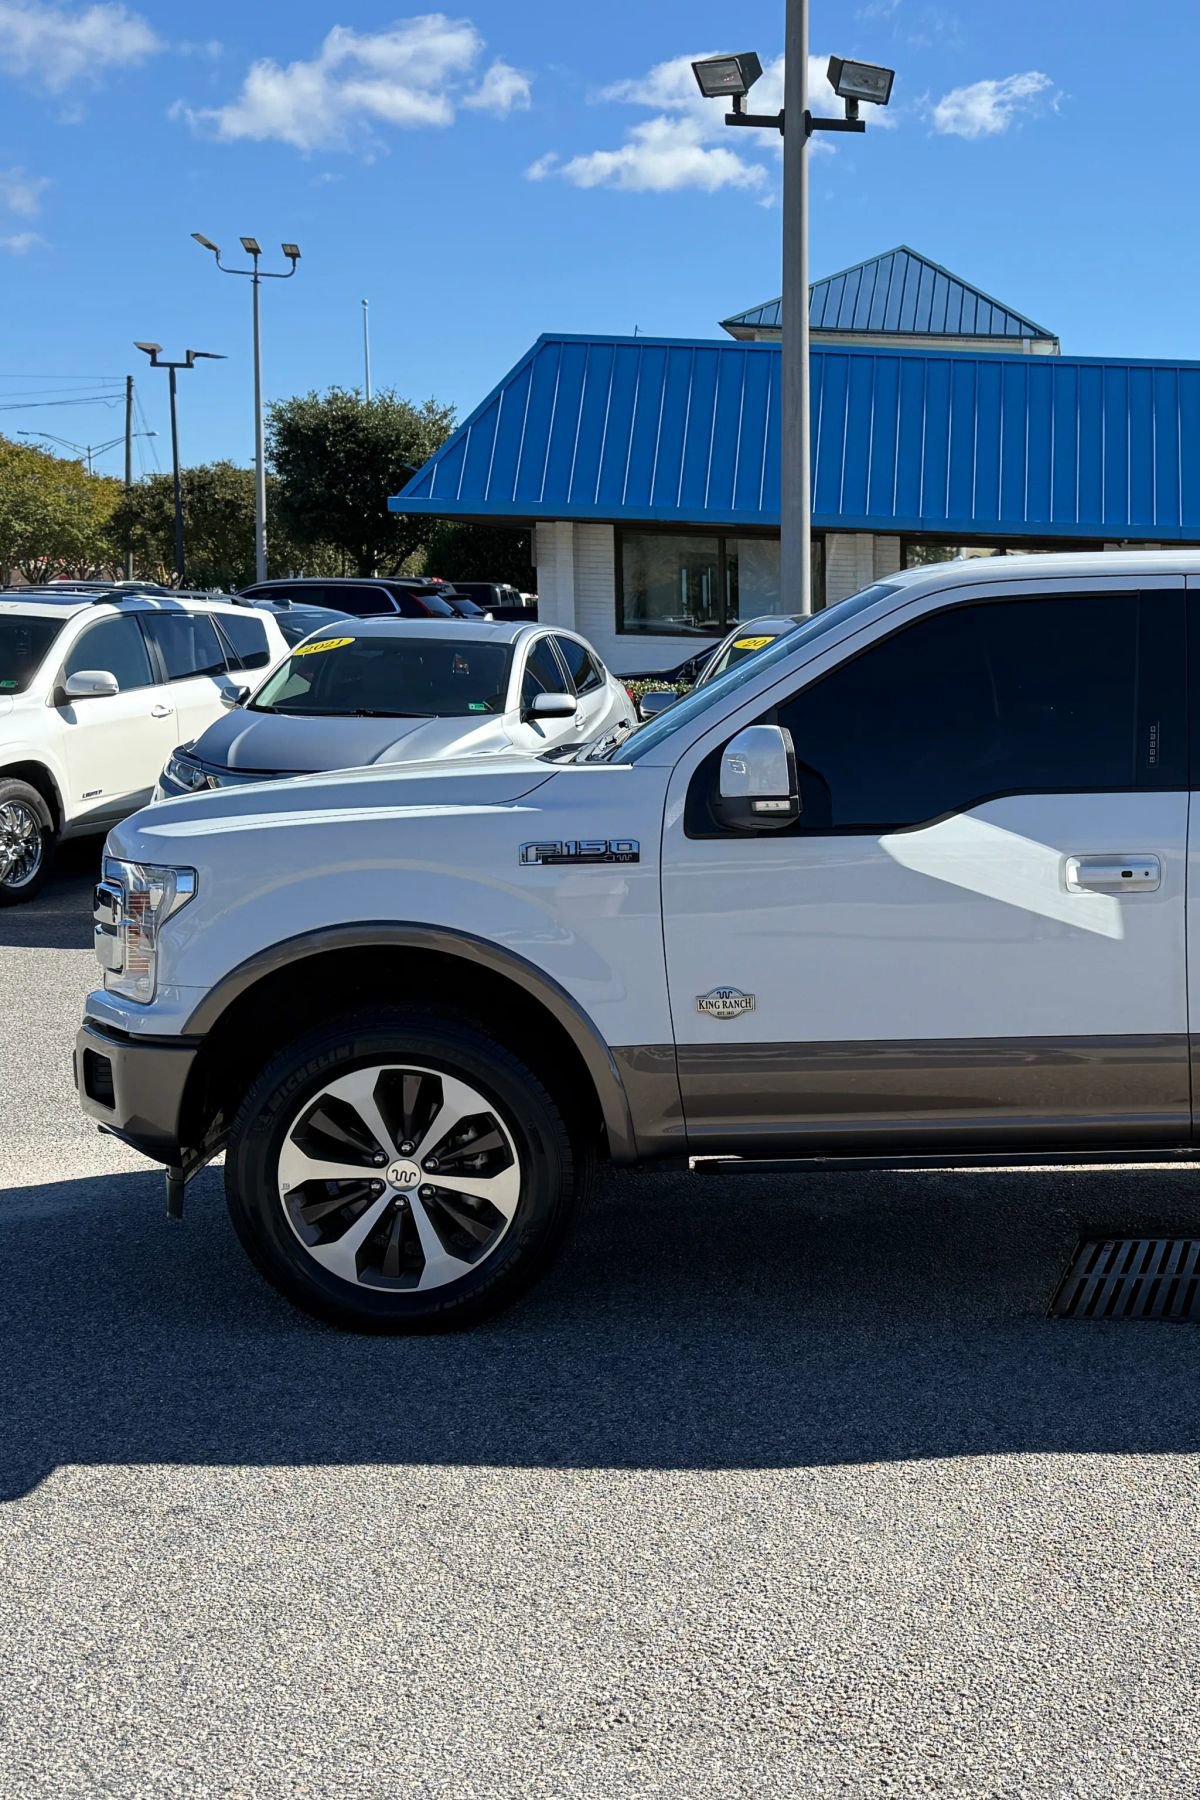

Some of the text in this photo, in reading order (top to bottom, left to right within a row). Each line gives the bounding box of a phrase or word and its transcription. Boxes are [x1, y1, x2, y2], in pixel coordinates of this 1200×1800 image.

[302, 639, 344, 653] 2021
[743, 639, 767, 647] 20
[698, 998, 752, 1010] KING RANCH
[268, 1044, 353, 1113] MICHELIN
